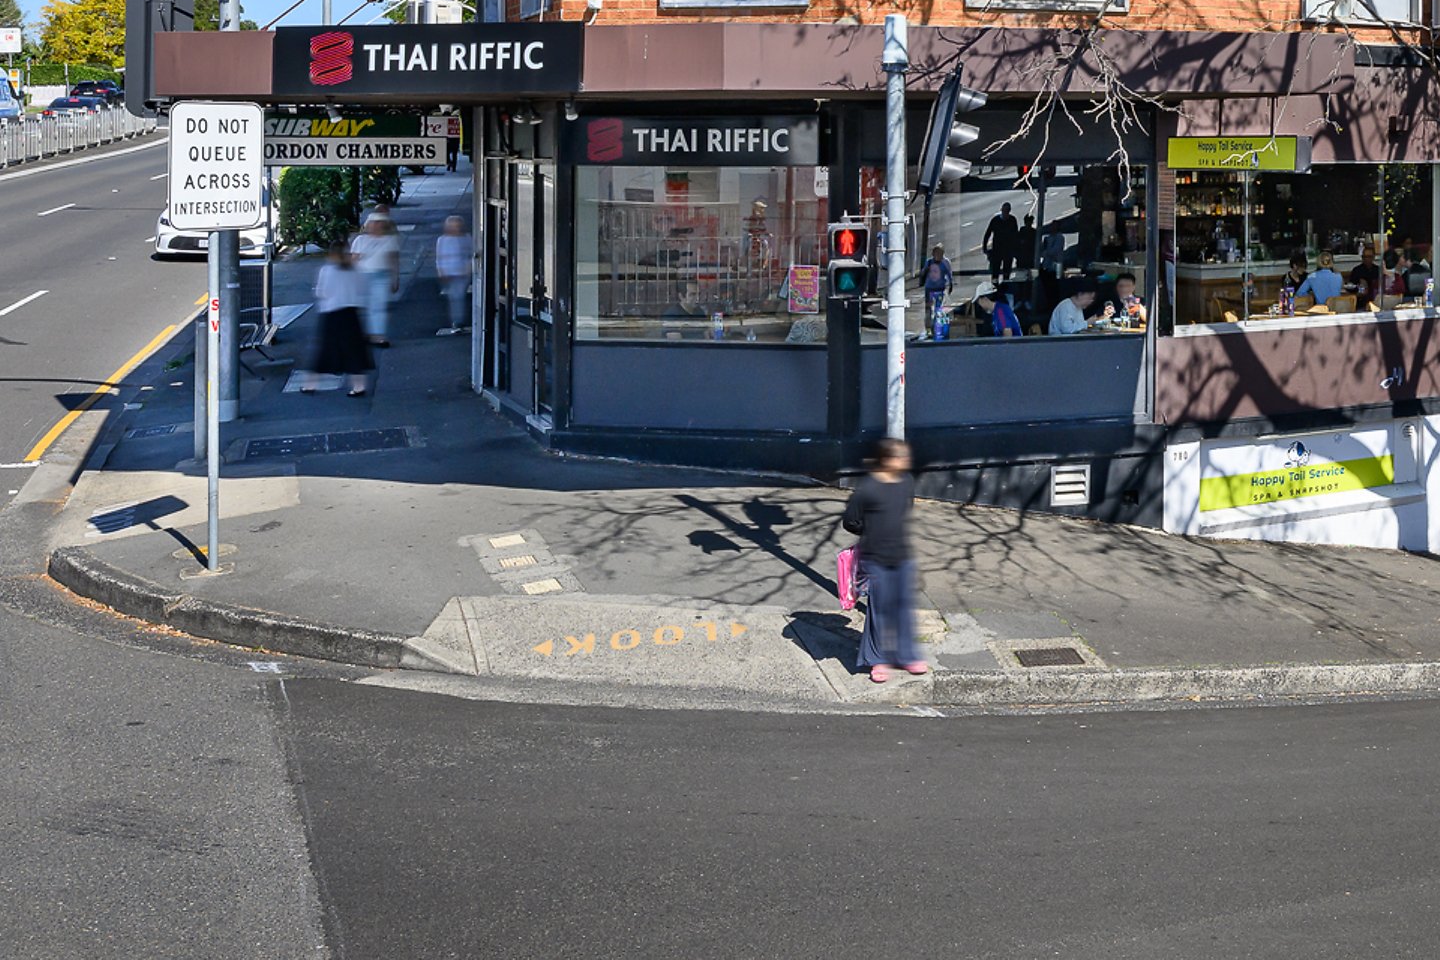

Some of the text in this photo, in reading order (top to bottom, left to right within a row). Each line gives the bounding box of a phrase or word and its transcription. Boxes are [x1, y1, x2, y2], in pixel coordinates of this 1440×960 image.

[363, 41, 544, 71] THAI RIFFIC
[186, 117, 250, 135] DO NOT
[264, 117, 376, 137] SUBWAY
[632, 128, 790, 152] THAI RIFFIC
[1198, 140, 1217, 153] Happy
[188, 146, 247, 162] QUEUE
[264, 143, 437, 160] ORDON CHAMBERS
[184, 173, 250, 190] ACROSS
[174, 200, 257, 215] INTERSECTION
[1250, 466, 1345, 487] Happy Tail Service
[563, 620, 717, 656] LOOK
